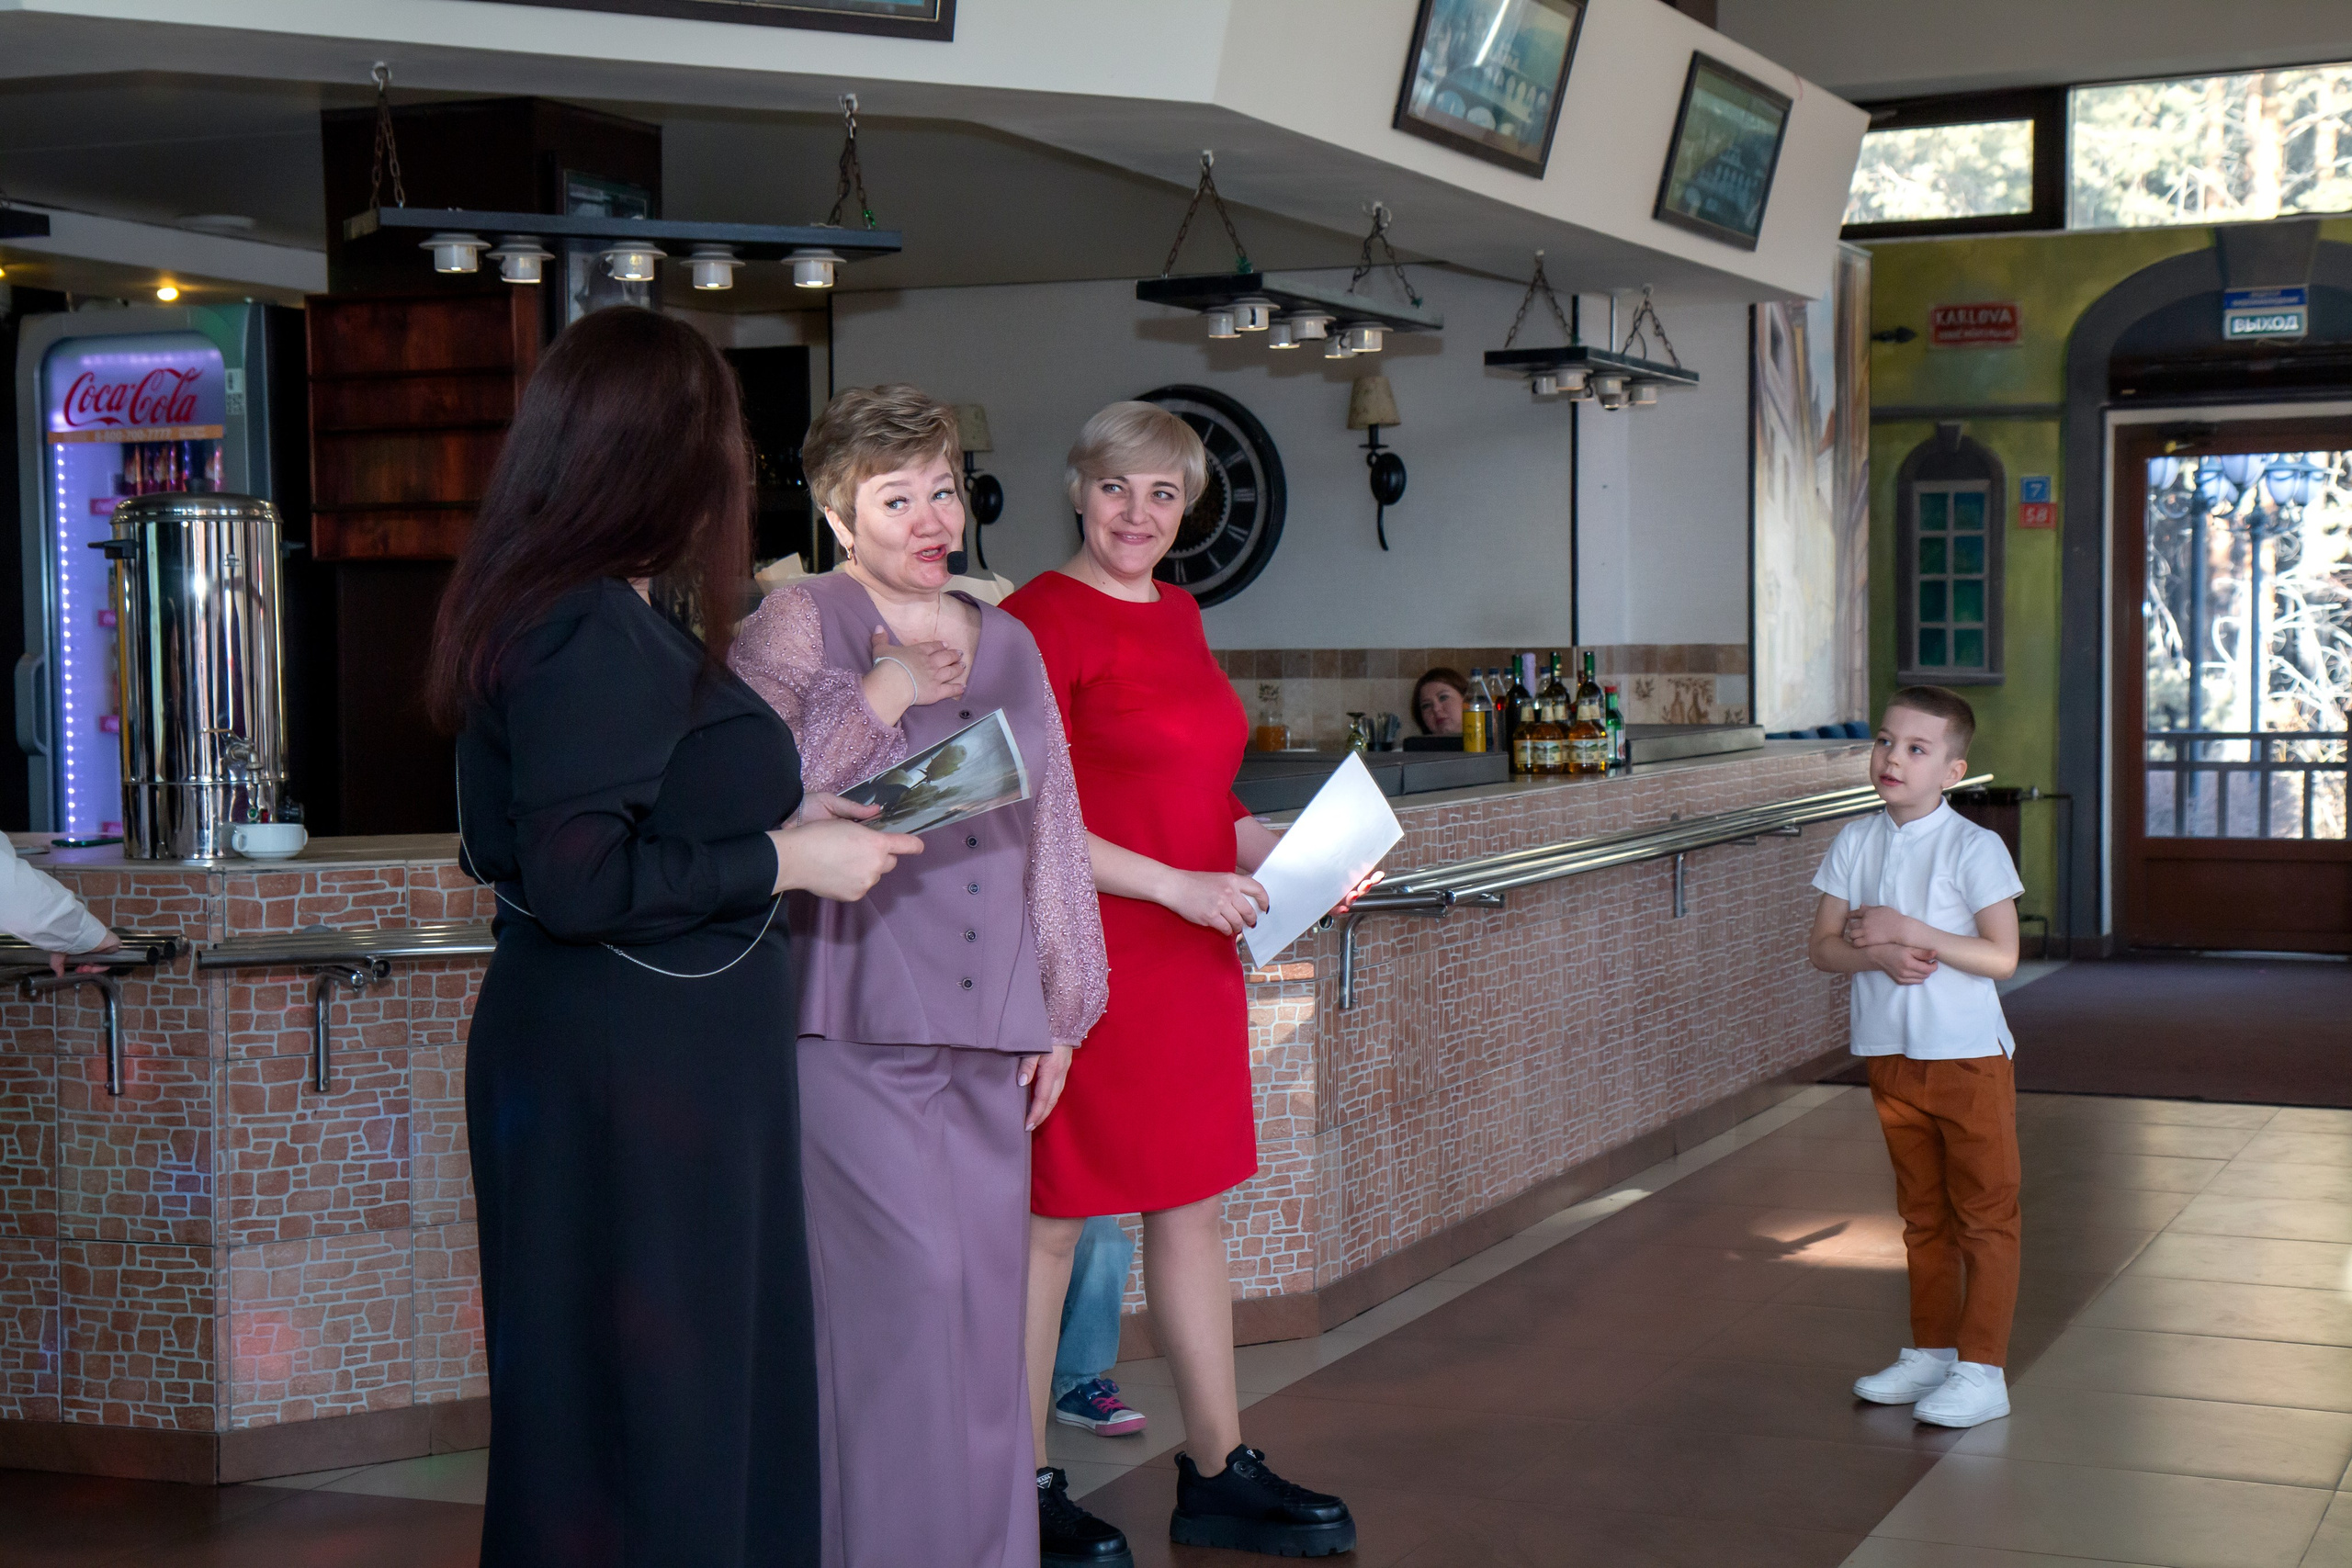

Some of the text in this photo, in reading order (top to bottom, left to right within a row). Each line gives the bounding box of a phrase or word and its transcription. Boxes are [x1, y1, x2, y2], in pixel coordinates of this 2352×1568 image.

[1935, 308, 2013, 325] KARLOVA
[2231, 315, 2299, 333] ВЫХОД
[63, 367, 204, 427] Coca-Cola
[2030, 482, 2042, 498] 7
